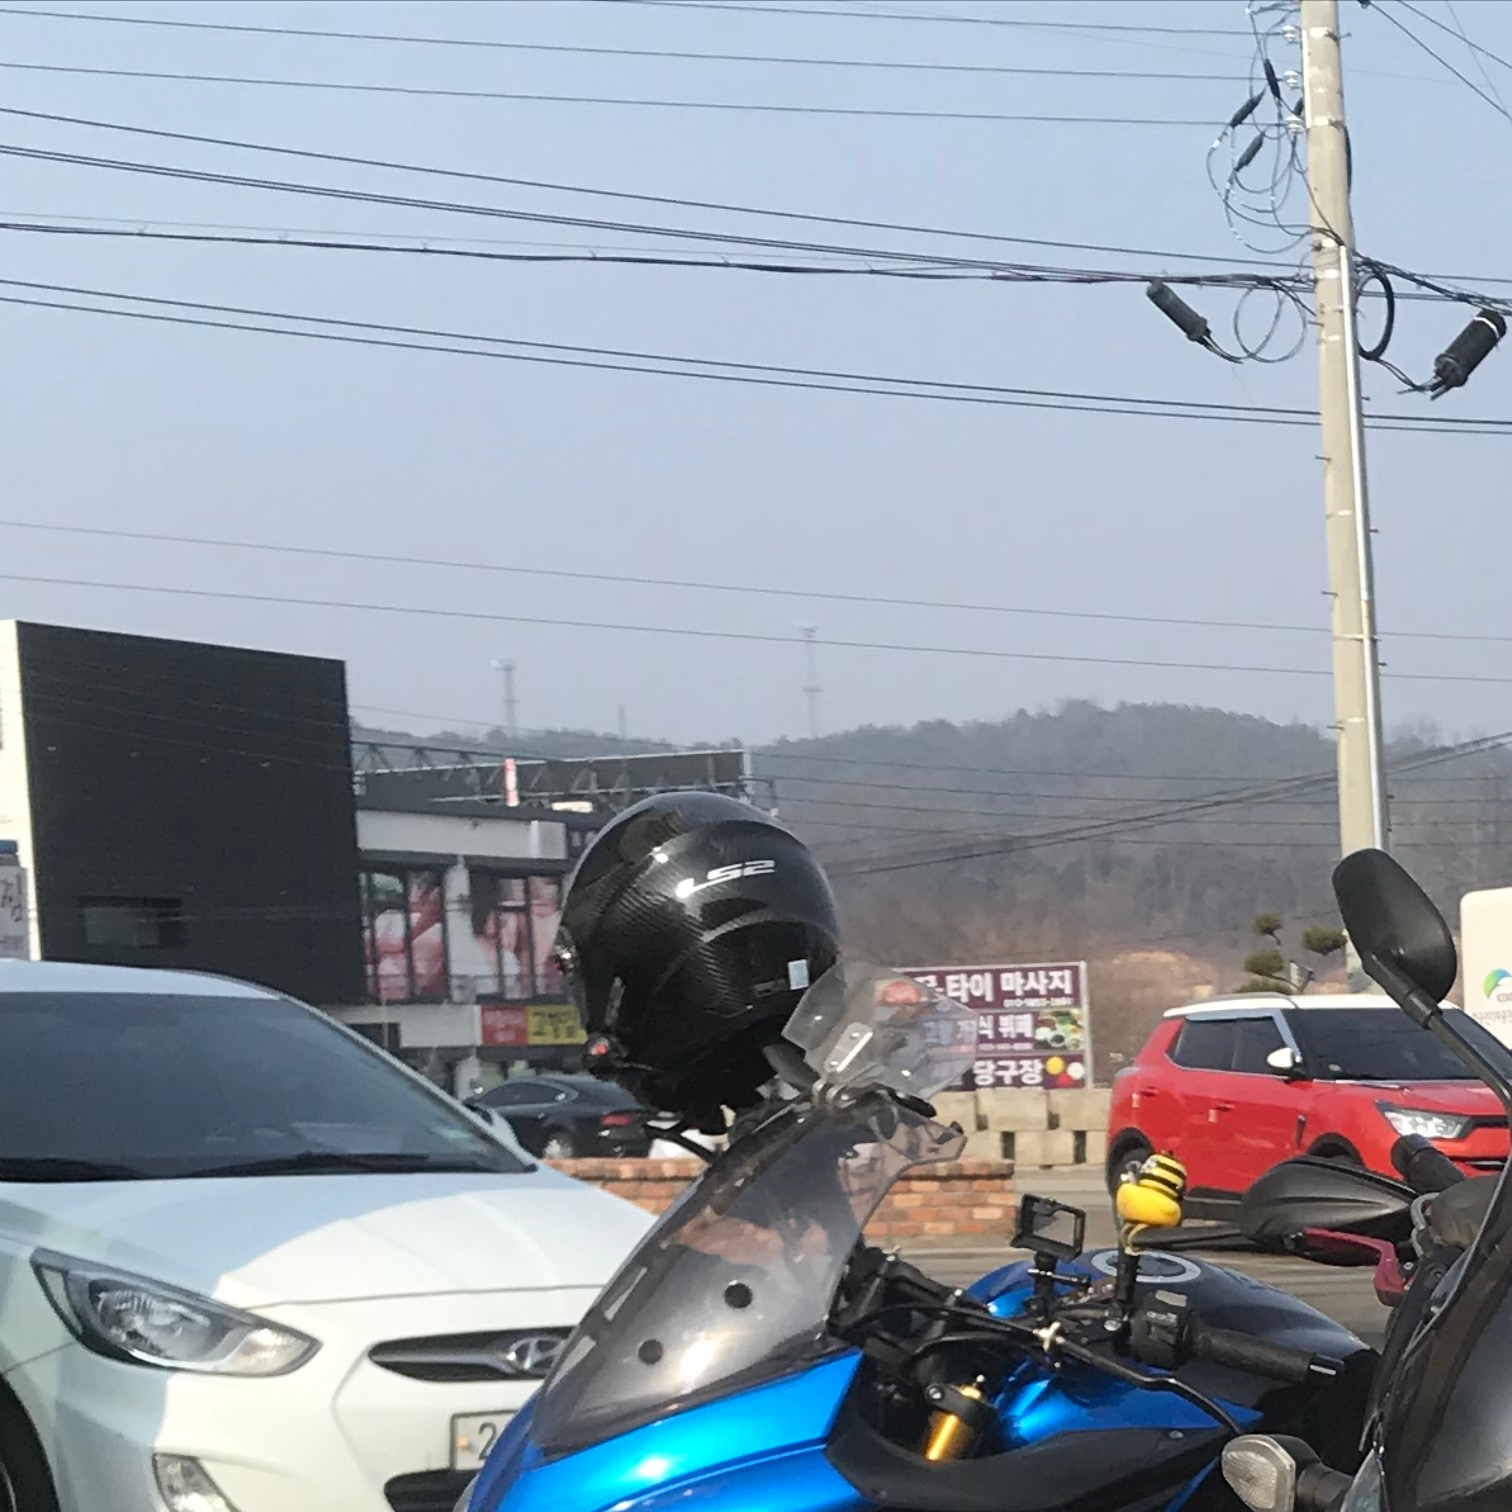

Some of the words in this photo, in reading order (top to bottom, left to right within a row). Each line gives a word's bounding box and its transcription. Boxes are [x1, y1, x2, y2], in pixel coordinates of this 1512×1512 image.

[676, 860, 776, 898] LS2
[1000, 969, 1073, 997] 마사지
[972, 1058, 1044, 1087] 당구장
